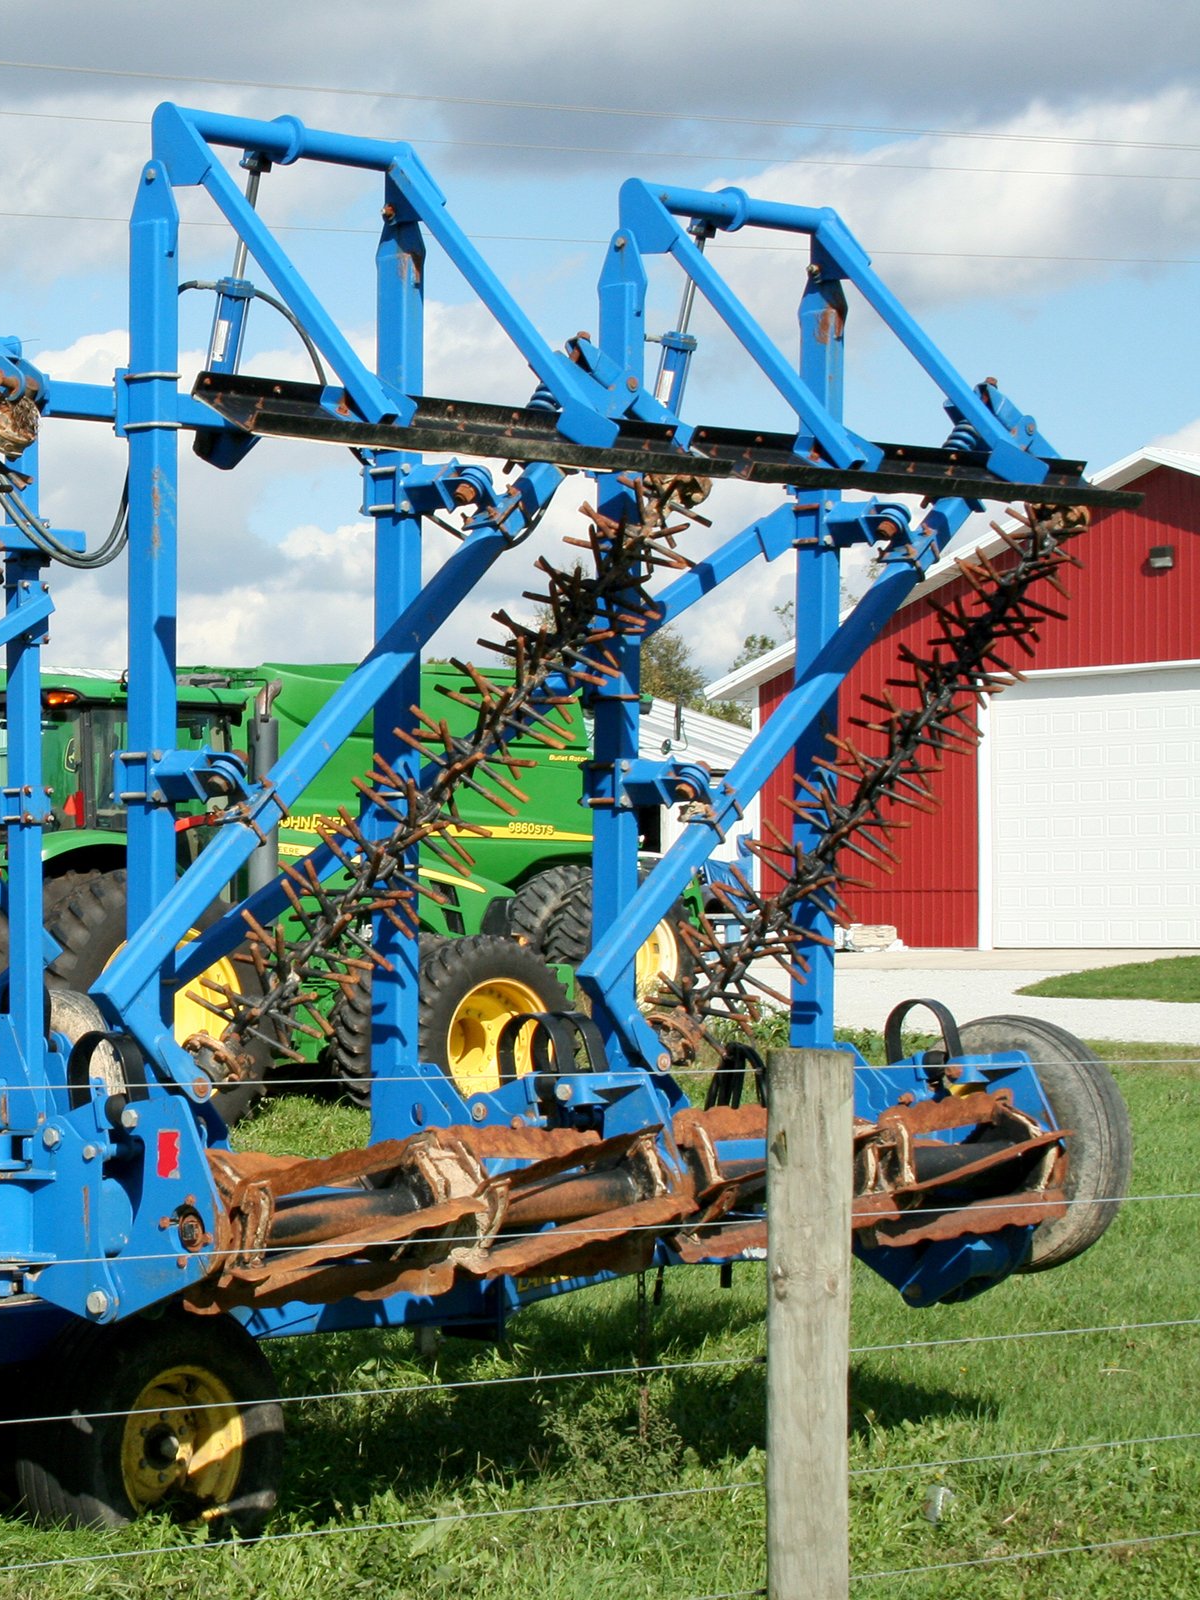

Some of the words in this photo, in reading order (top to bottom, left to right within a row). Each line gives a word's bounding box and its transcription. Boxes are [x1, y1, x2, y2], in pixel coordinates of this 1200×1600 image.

[548, 754, 568, 762] Bullet
[278, 815, 311, 829] OHN
[508, 822, 554, 835] 9860STS
